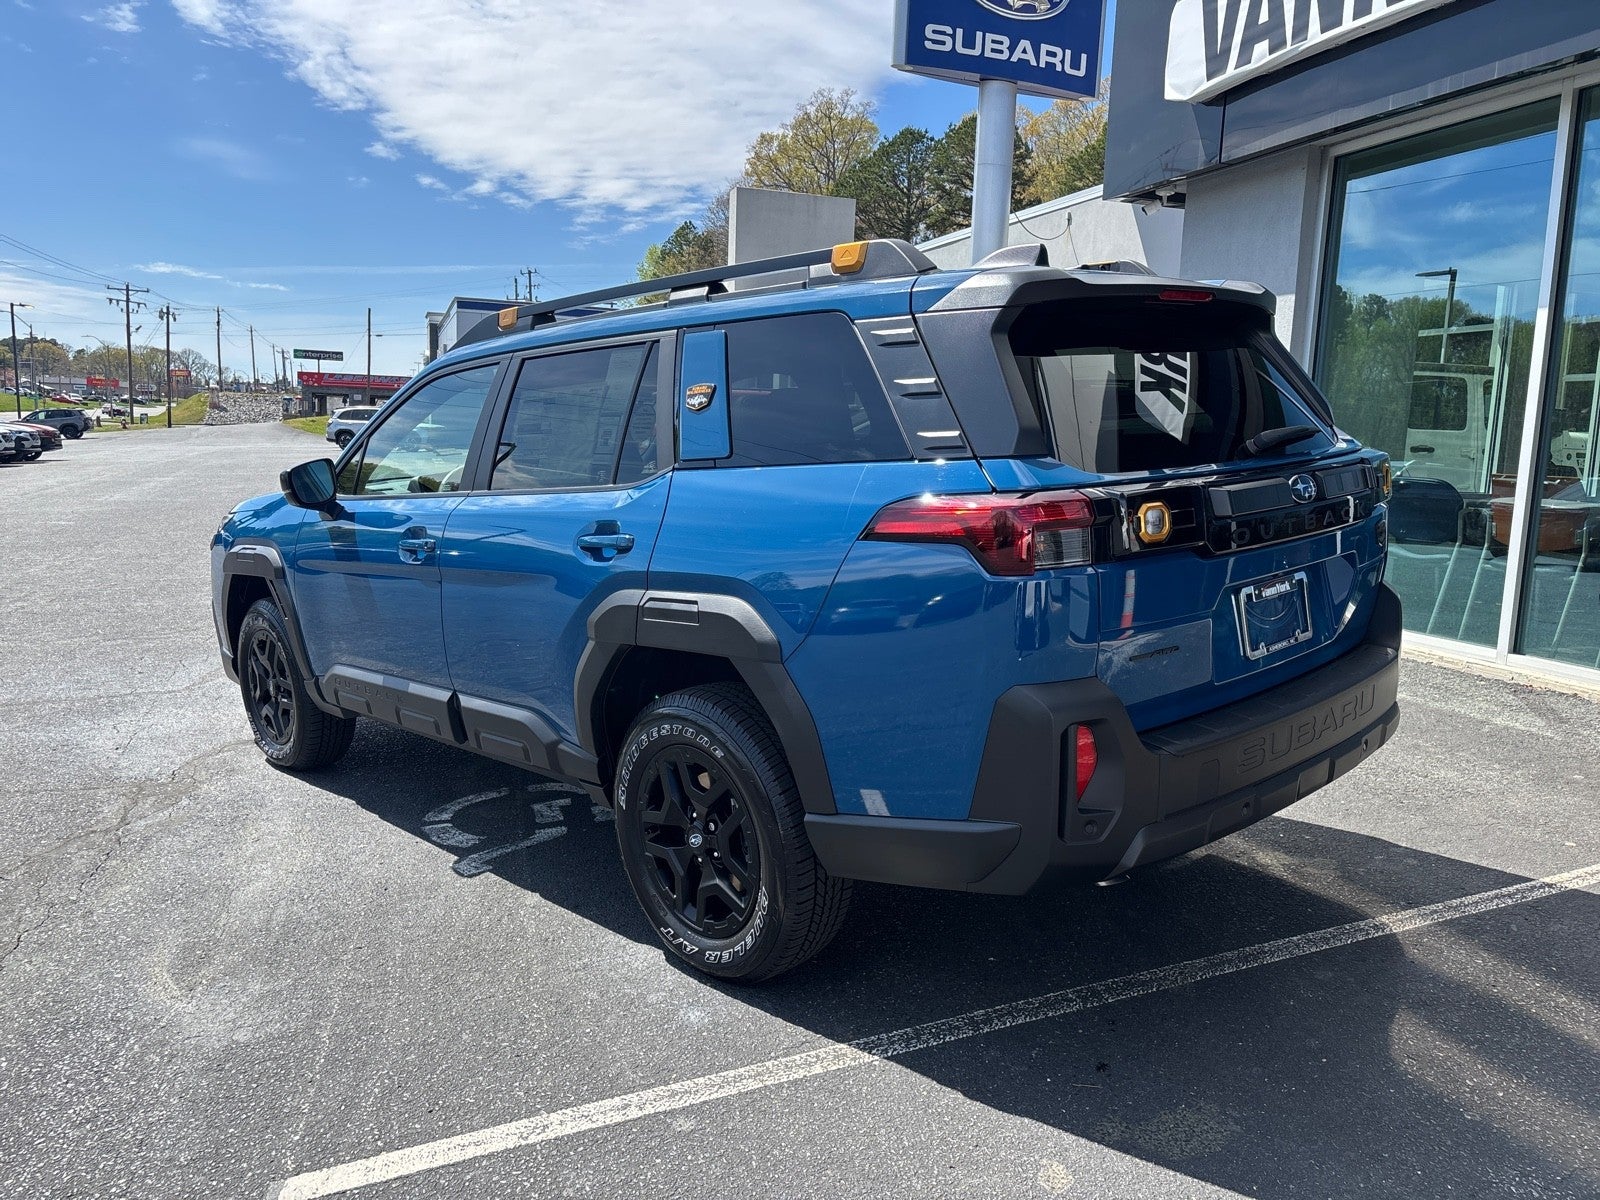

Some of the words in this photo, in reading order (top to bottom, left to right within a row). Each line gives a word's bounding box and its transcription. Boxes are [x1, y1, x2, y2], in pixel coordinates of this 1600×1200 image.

[923, 23, 1088, 78] SUBARU
[1203, 0, 1406, 82] VAN
[296, 351, 343, 359] enterprise
[1232, 501, 1366, 545] OUTBACK
[1237, 684, 1376, 774] SUBARU
[618, 724, 725, 810] BRIDGESTONE
[661, 926, 699, 957] A/T
[704, 885, 770, 964] DUELER
